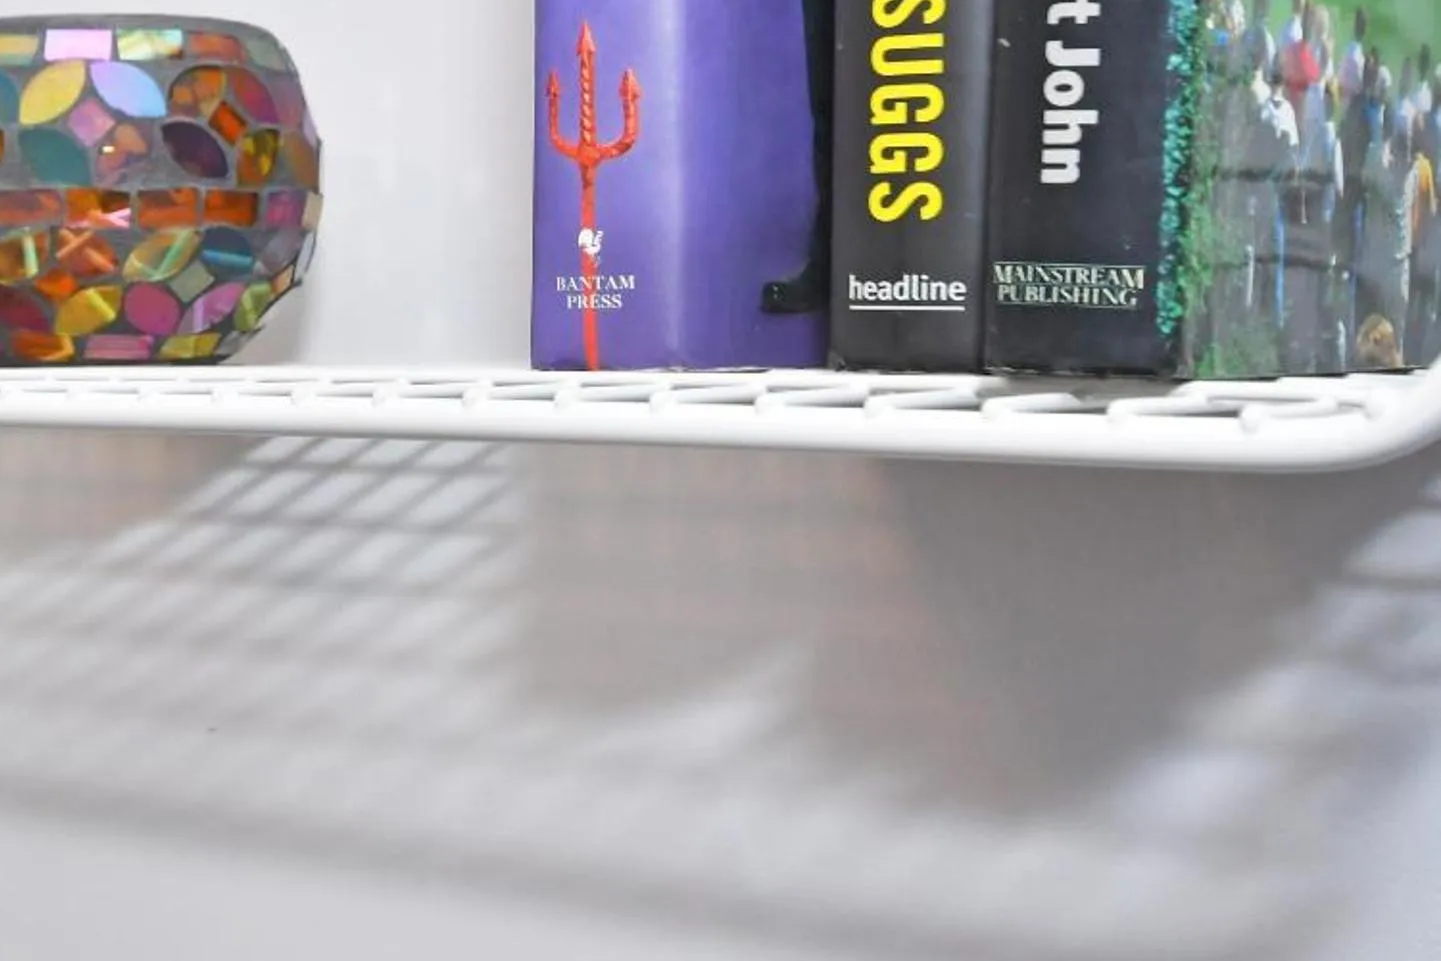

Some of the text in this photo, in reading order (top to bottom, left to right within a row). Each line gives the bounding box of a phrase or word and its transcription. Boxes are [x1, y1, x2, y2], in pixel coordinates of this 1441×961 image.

[1040, 40, 1101, 184] John
[556, 274, 635, 292] BANTAM
[849, 274, 967, 303] headline
[993, 262, 1146, 290] MAINSTREAM
[566, 293, 623, 310] PRESS
[996, 284, 1139, 307] PUBLISHING
